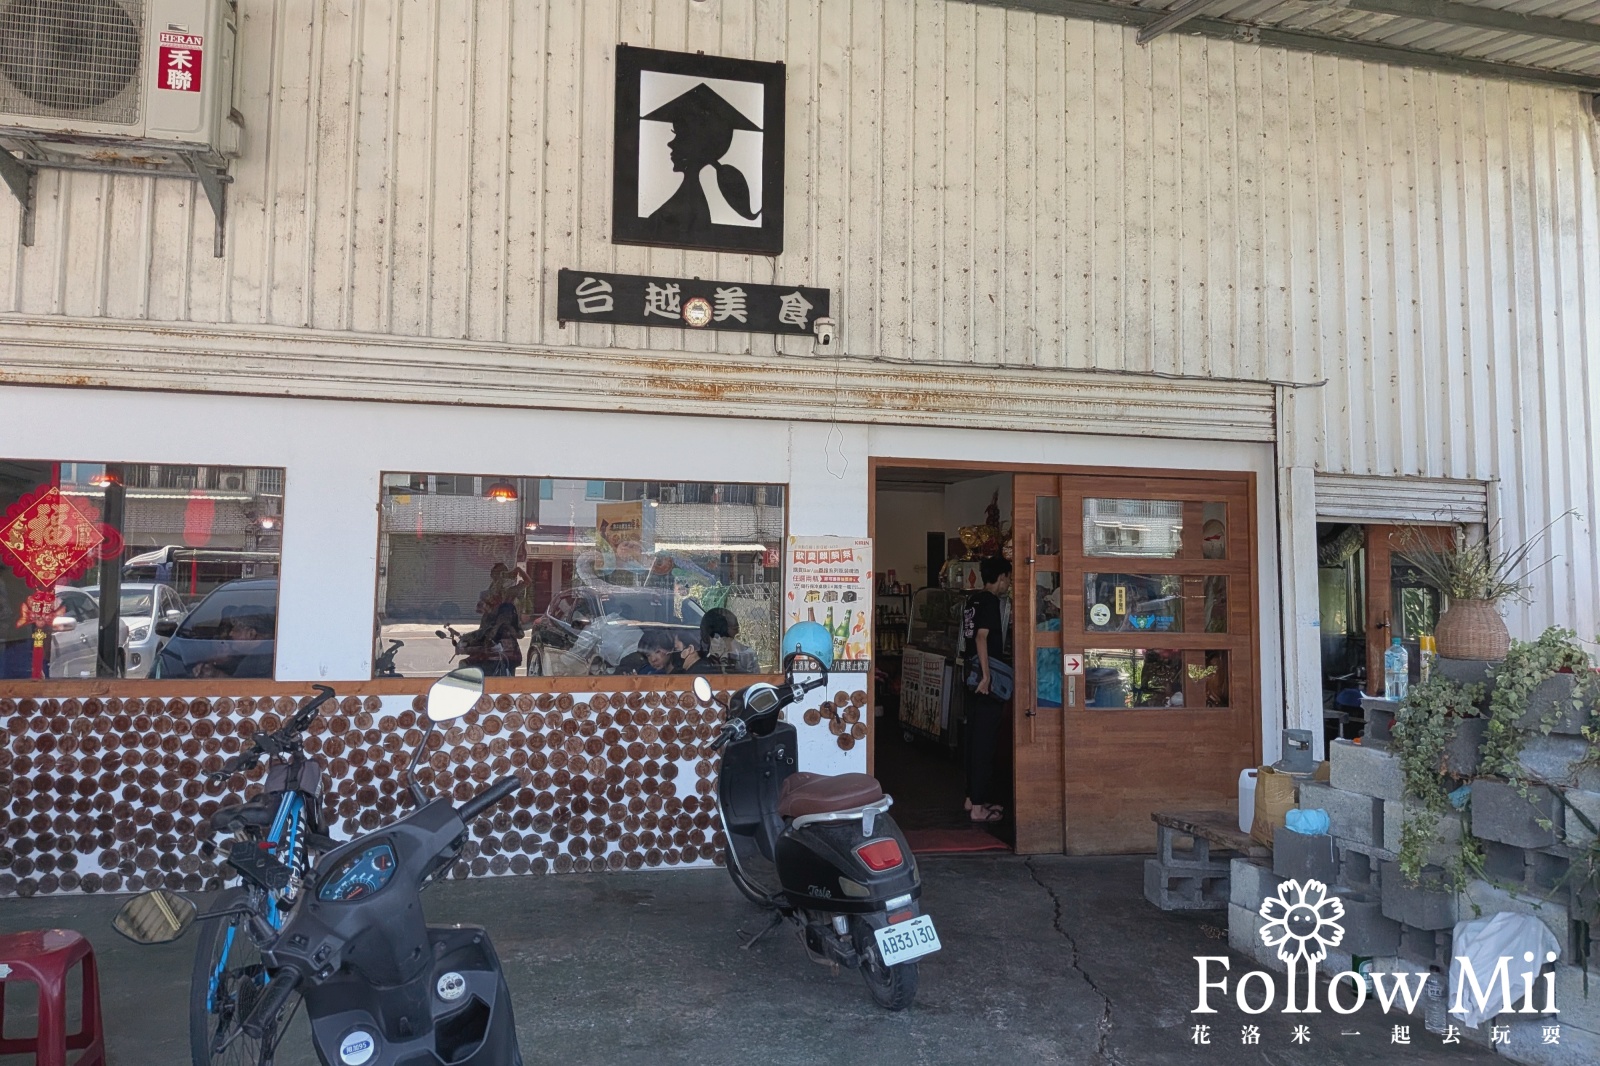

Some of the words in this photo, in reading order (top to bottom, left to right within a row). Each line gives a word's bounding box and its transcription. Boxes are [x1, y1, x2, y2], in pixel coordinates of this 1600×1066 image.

[161, 33, 202, 45] HERAN
[167, 49, 193, 90] 禾聯
[575, 276, 814, 330] 台越美食
[28, 503, 73, 547] 福
[881, 925, 936, 956] AB33130
